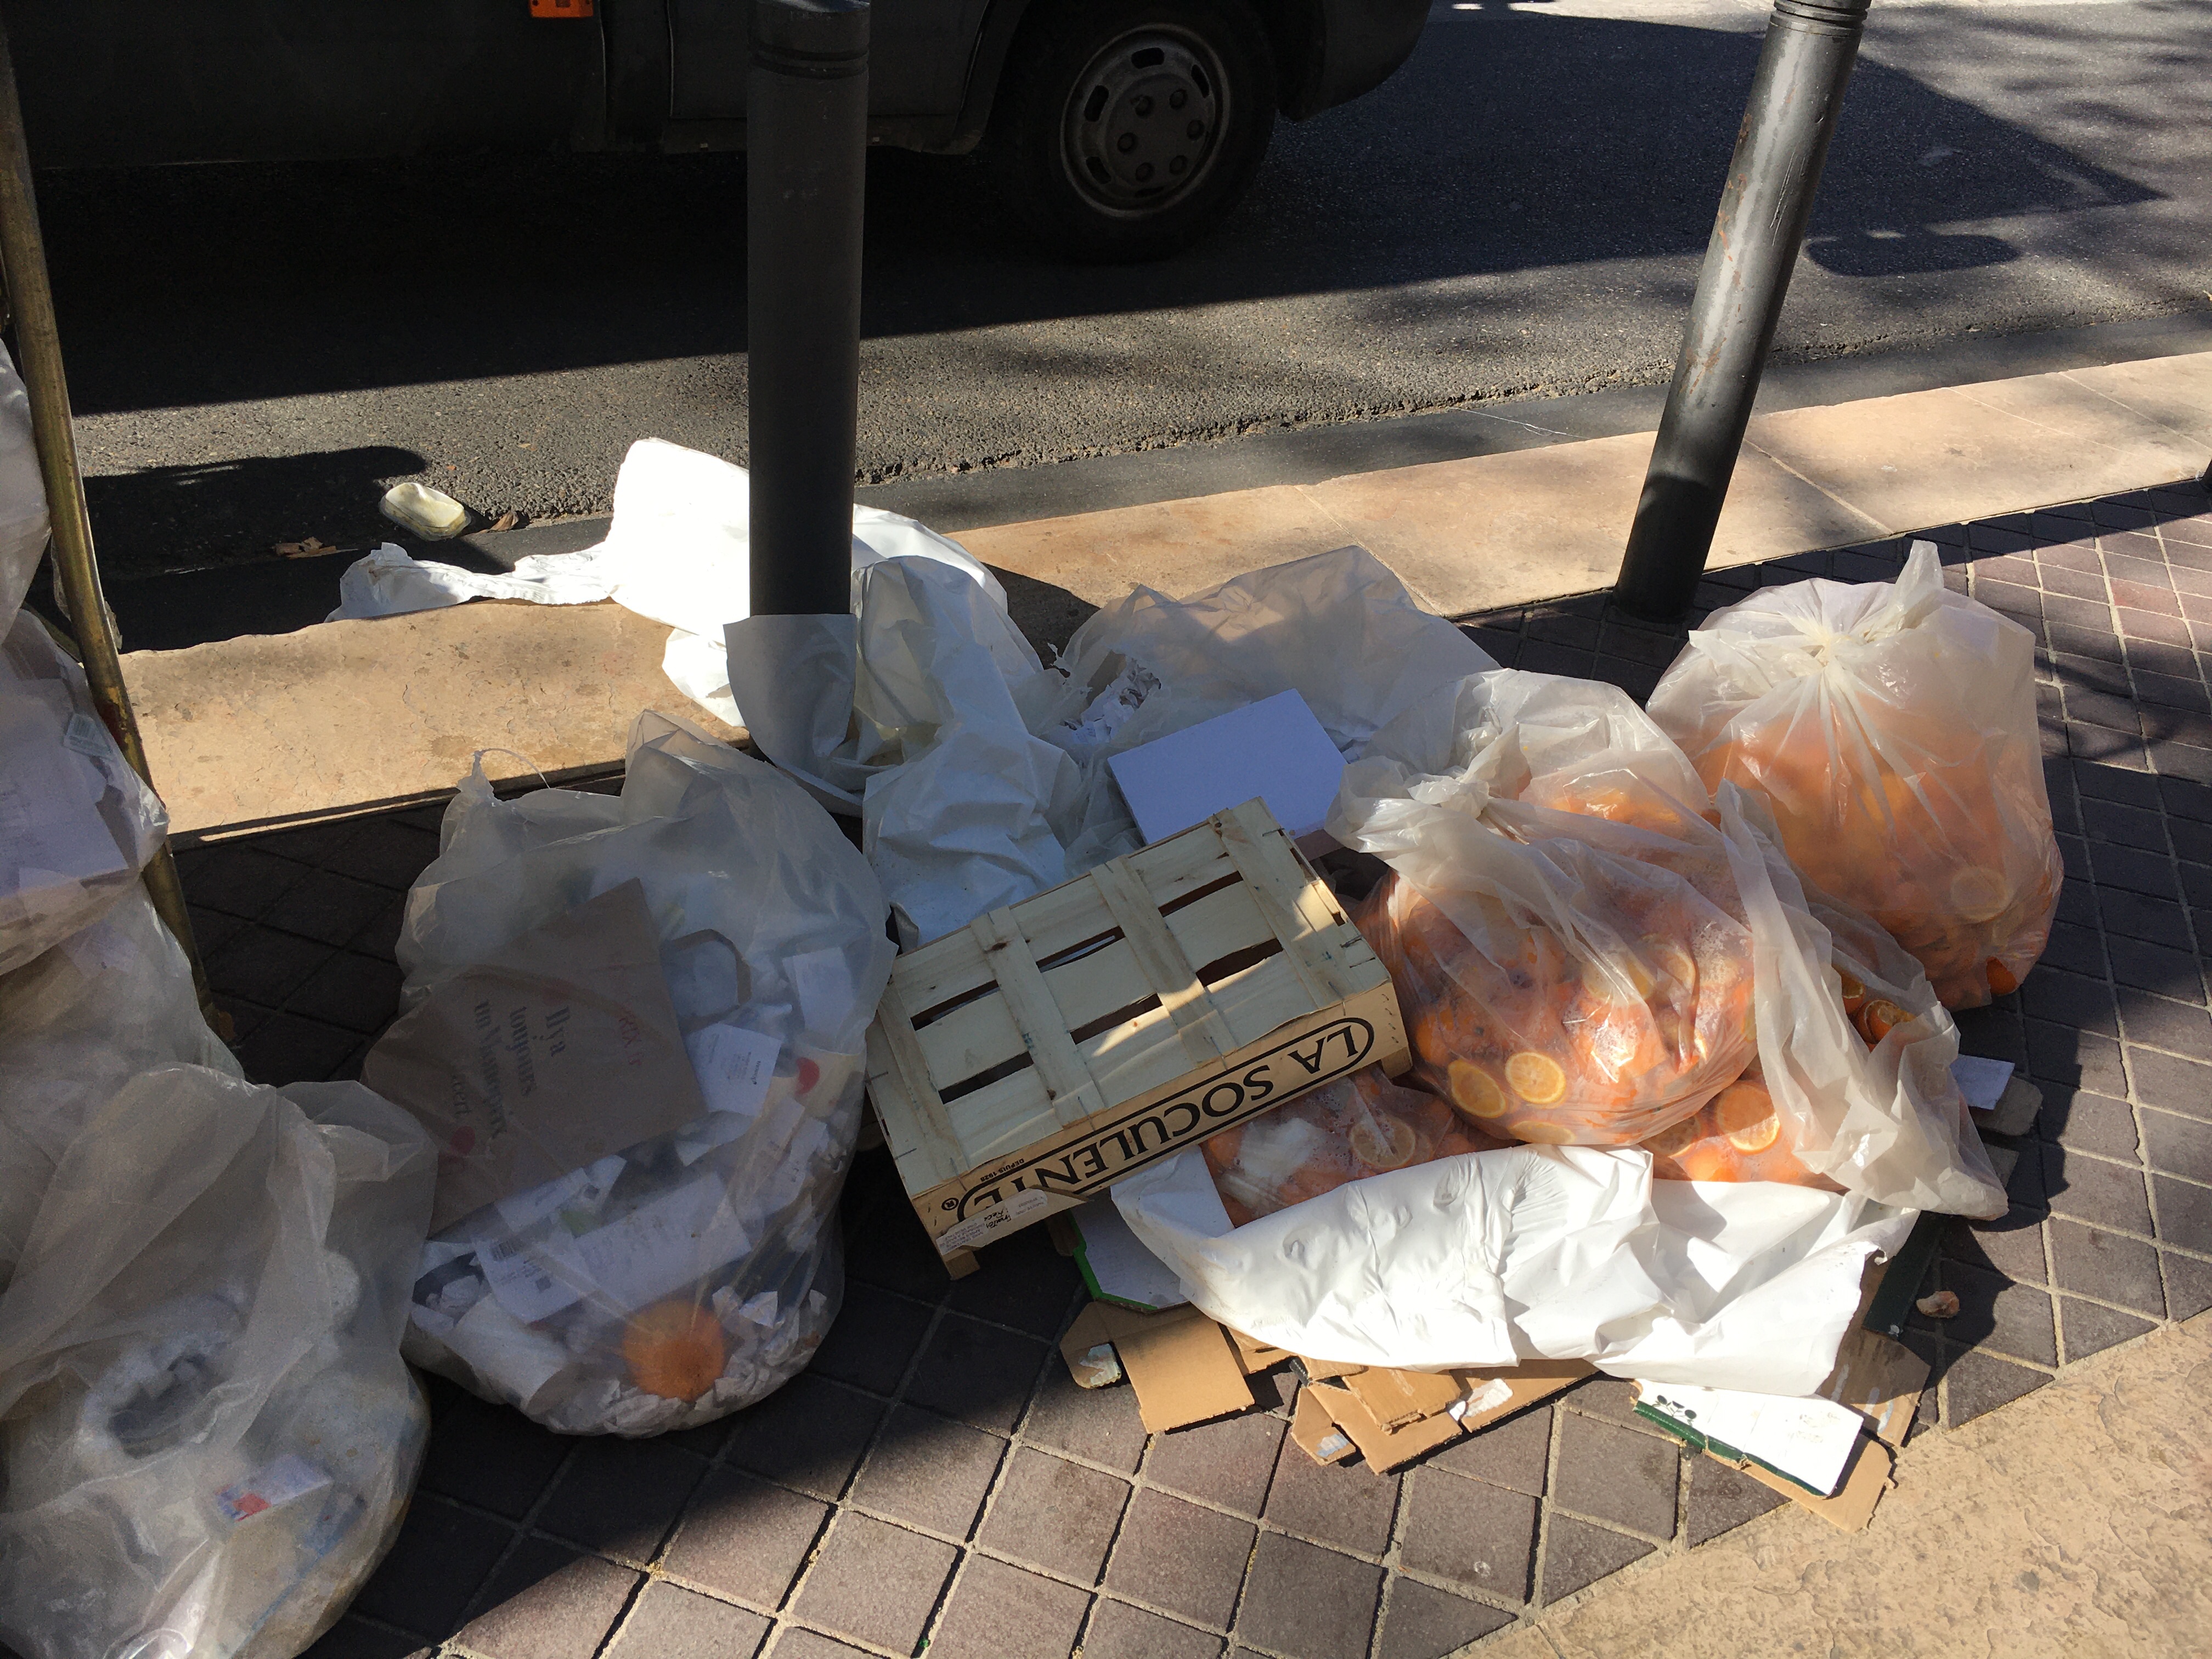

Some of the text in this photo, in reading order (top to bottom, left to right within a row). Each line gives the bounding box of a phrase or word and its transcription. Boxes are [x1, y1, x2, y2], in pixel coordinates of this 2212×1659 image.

[506, 1006, 538, 1097] toujours
[539, 1005, 571, 1058] Il y a
[1288, 1026, 1359, 1075] LA
[980, 1158, 1025, 1182] DEPUIS 1928
